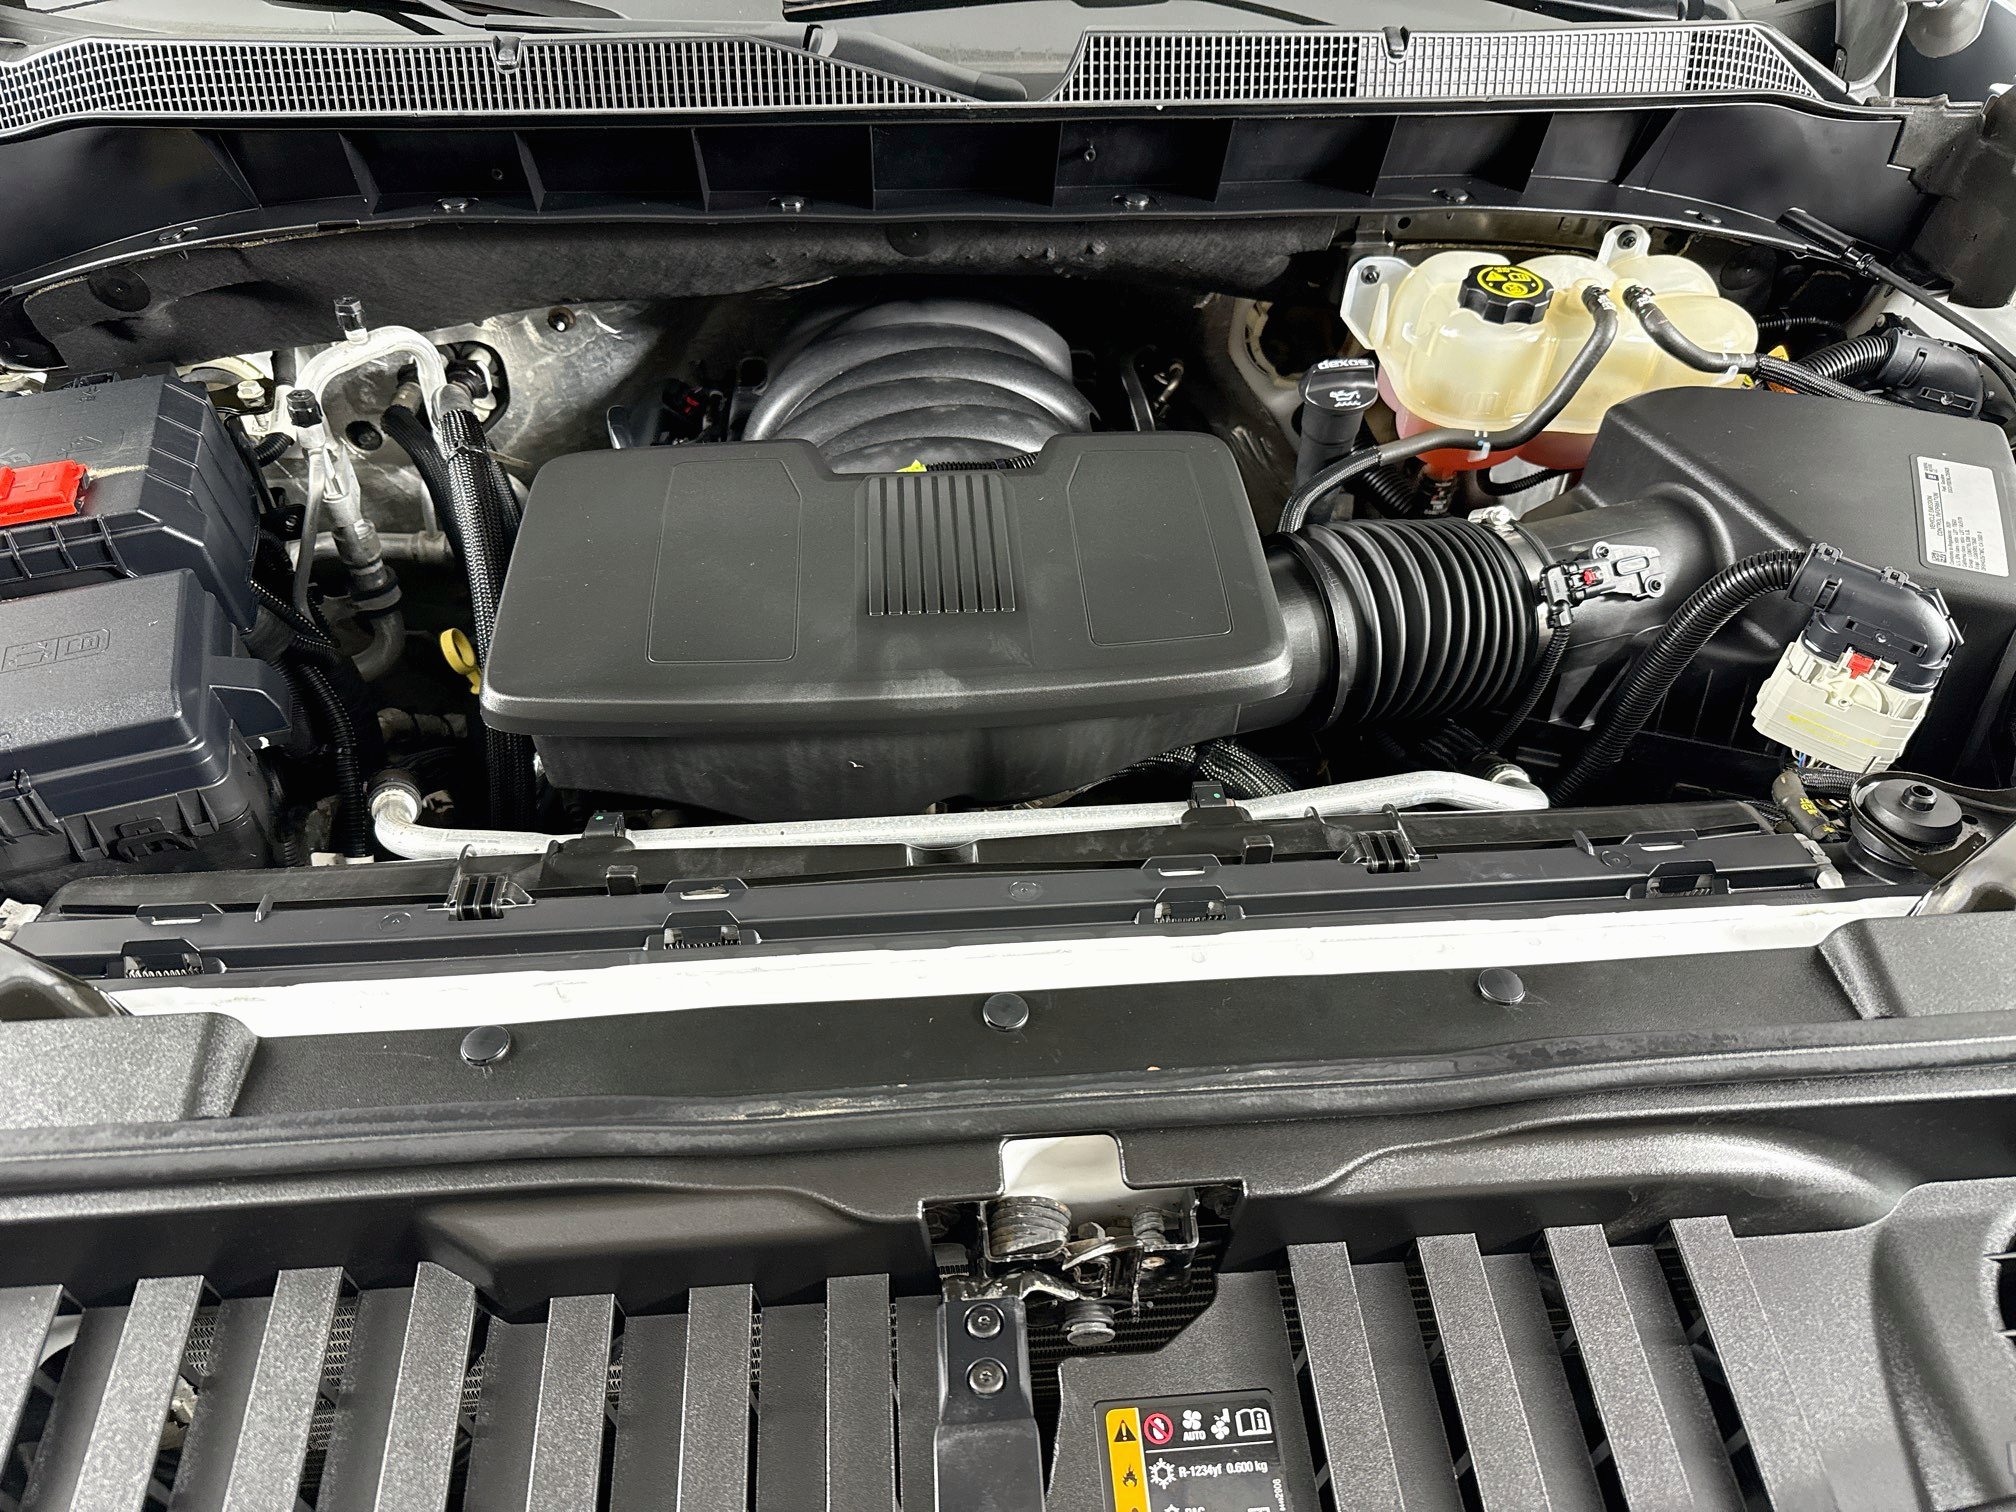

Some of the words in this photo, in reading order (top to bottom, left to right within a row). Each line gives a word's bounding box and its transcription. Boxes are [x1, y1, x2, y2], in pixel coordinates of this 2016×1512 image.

[1318, 359, 1369, 369] dexos
[1183, 1430, 1206, 1441] AUTO
[1178, 1463, 1222, 1478] R-1234yf
[1226, 1461, 1254, 1474] 0.600
[1254, 1460, 1268, 1473] kg
